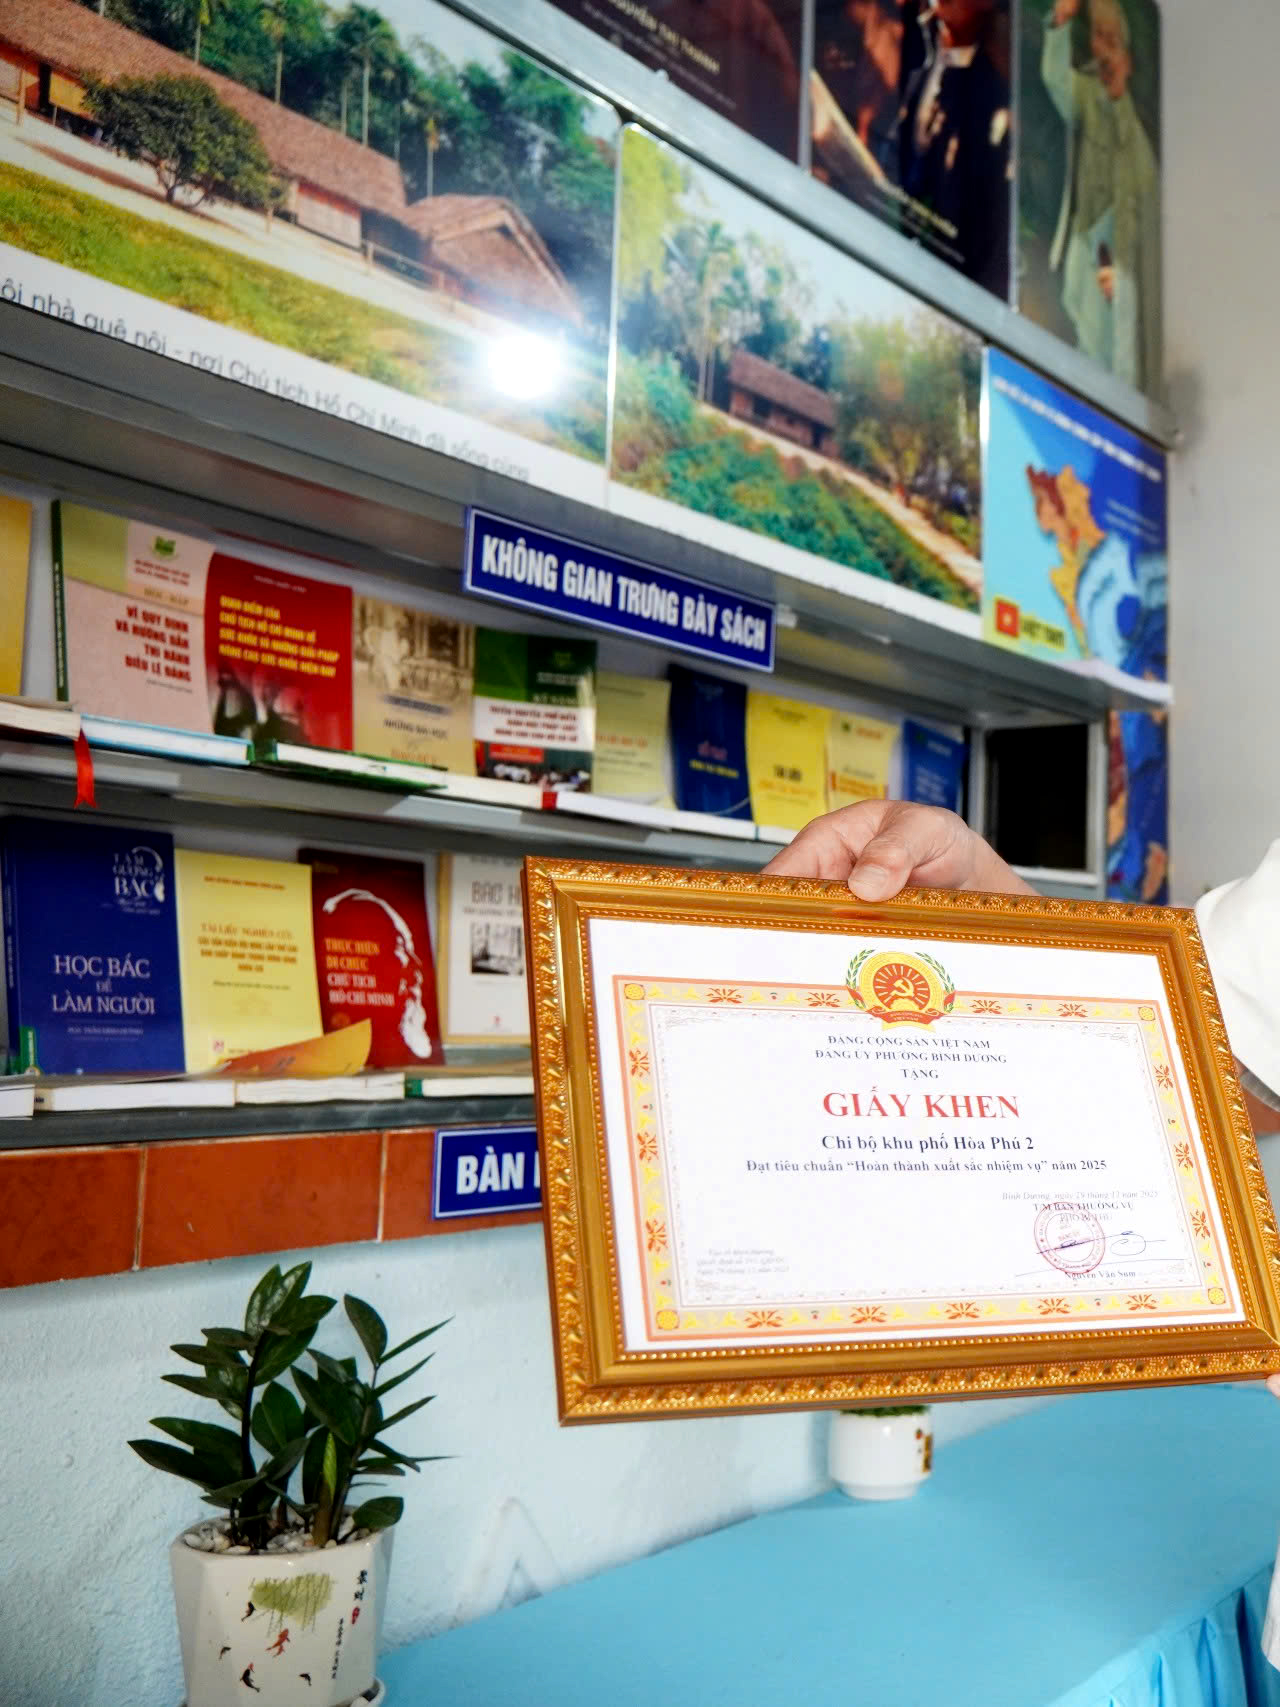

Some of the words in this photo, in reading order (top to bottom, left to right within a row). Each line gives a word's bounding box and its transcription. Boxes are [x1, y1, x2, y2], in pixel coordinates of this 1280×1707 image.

[32, 293, 76, 322] nhà
[190, 349, 223, 372] nơi
[481, 533, 559, 593] KHÔNG
[562, 559, 614, 609] GIAN
[616, 574, 680, 627] TRƯNG
[681, 593, 719, 638] BÀY
[720, 605, 767, 653] SÁCH
[54, 954, 103, 981] HỌC
[107, 952, 151, 979] BÁC
[51, 992, 93, 1014] LÀM
[98, 993, 156, 1016] NGƯỜI
[827, 1033, 864, 1046] ĐẢNG
[867, 1036, 904, 1048] CỘNG
[906, 1036, 930, 1047] SẢN
[932, 1037, 961, 1050] VIỆT
[963, 1039, 991, 1050] NAM
[815, 1048, 851, 1060] ĐẢNG
[875, 1049, 929, 1062] PHƯỜNG
[931, 1050, 961, 1063] BÌNH
[964, 1053, 1007, 1064] DƯƠNG
[900, 1068, 939, 1081] TẶNG
[822, 1085, 912, 1118] GIẤY
[923, 1094, 1021, 1119] KHEN
[821, 1135, 852, 1150] Chi
[857, 1135, 878, 1153] bộ
[882, 1135, 914, 1150] khu
[918, 1132, 950, 1153] phố
[953, 1136, 986, 1150] Hòa
[990, 1135, 1022, 1150] Phú
[1025, 1136, 1035, 1150] 2
[456, 1144, 526, 1196] BÀN
[746, 1159, 770, 1174] Đạt
[775, 1159, 800, 1172] tiêu
[803, 1157, 844, 1172] chuẩn
[893, 1160, 930, 1172] thành
[933, 1157, 960, 1172] xuất
[963, 1158, 983, 1172] sắc
[986, 1159, 1024, 1173] nhiệm
[1051, 1159, 1078, 1171] năm
[1080, 1159, 1108, 1171] 2025
